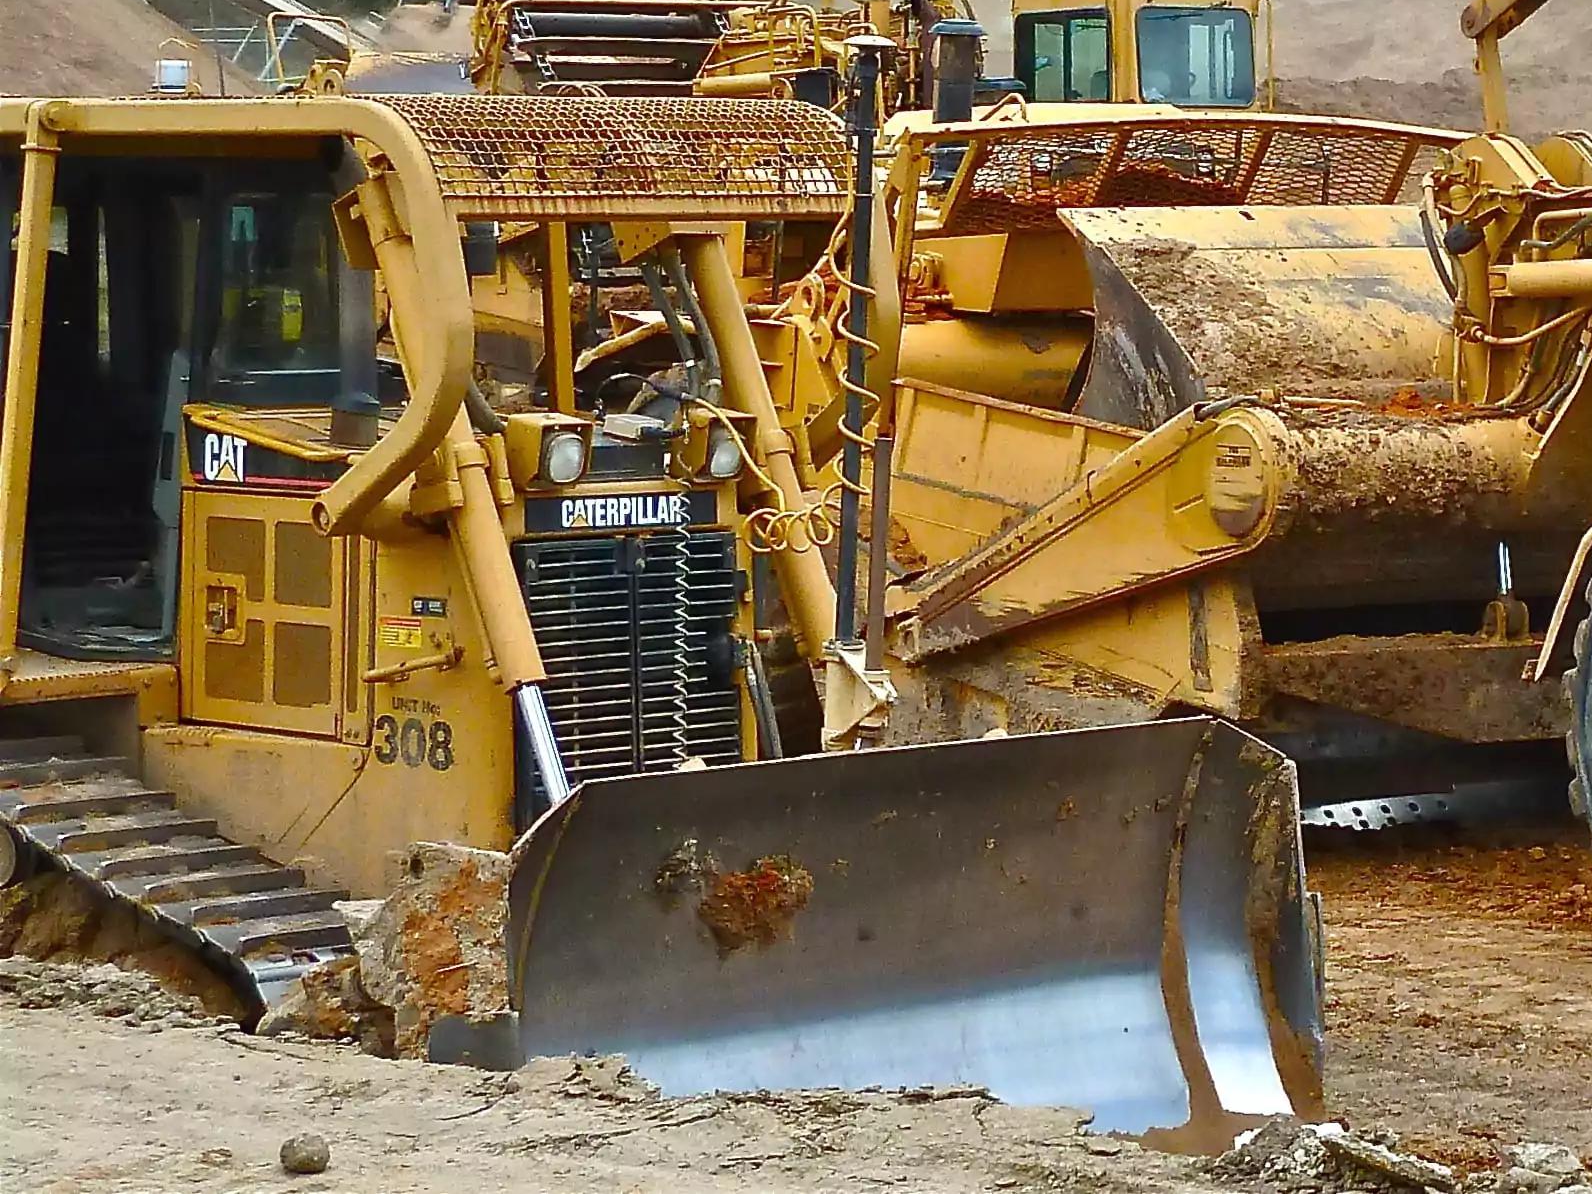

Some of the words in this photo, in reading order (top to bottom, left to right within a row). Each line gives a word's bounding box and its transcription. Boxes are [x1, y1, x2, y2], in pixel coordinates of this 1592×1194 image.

[204, 433, 248, 483] CAT
[561, 495, 682, 528] CATERPILLAR
[374, 714, 455, 772] 308
